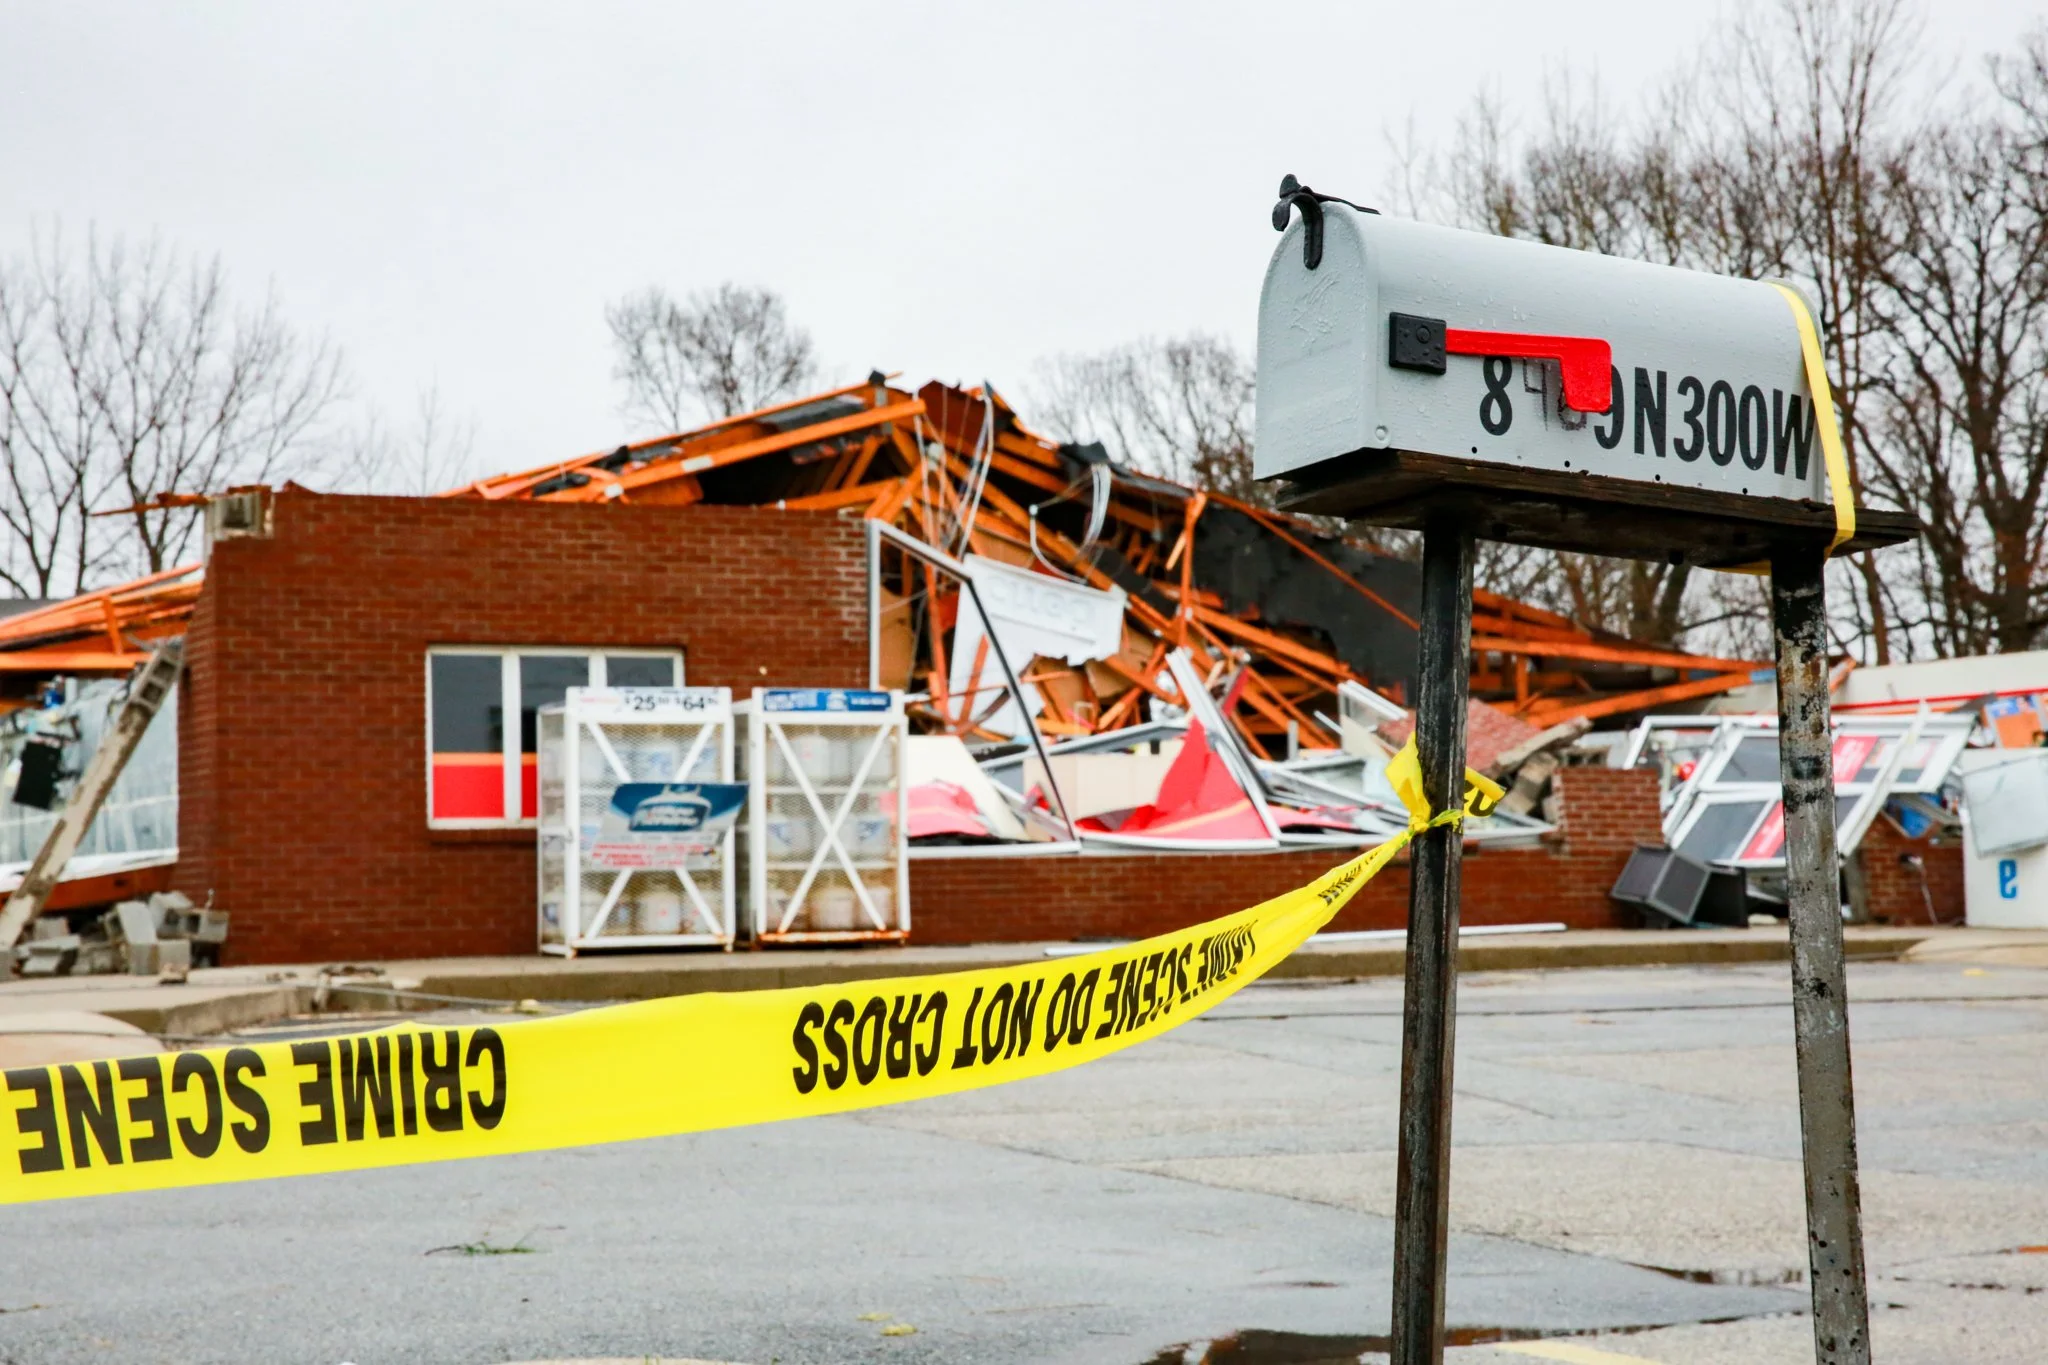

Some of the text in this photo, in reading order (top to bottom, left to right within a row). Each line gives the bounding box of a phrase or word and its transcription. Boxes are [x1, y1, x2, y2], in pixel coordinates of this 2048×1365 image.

[951, 978, 1045, 1070] NOT
[1044, 968, 1101, 1052] DO
[1094, 942, 1193, 1040] SCENE
[792, 991, 948, 1094] CROSS
[4, 1027, 508, 1174] CRIME SCENE
